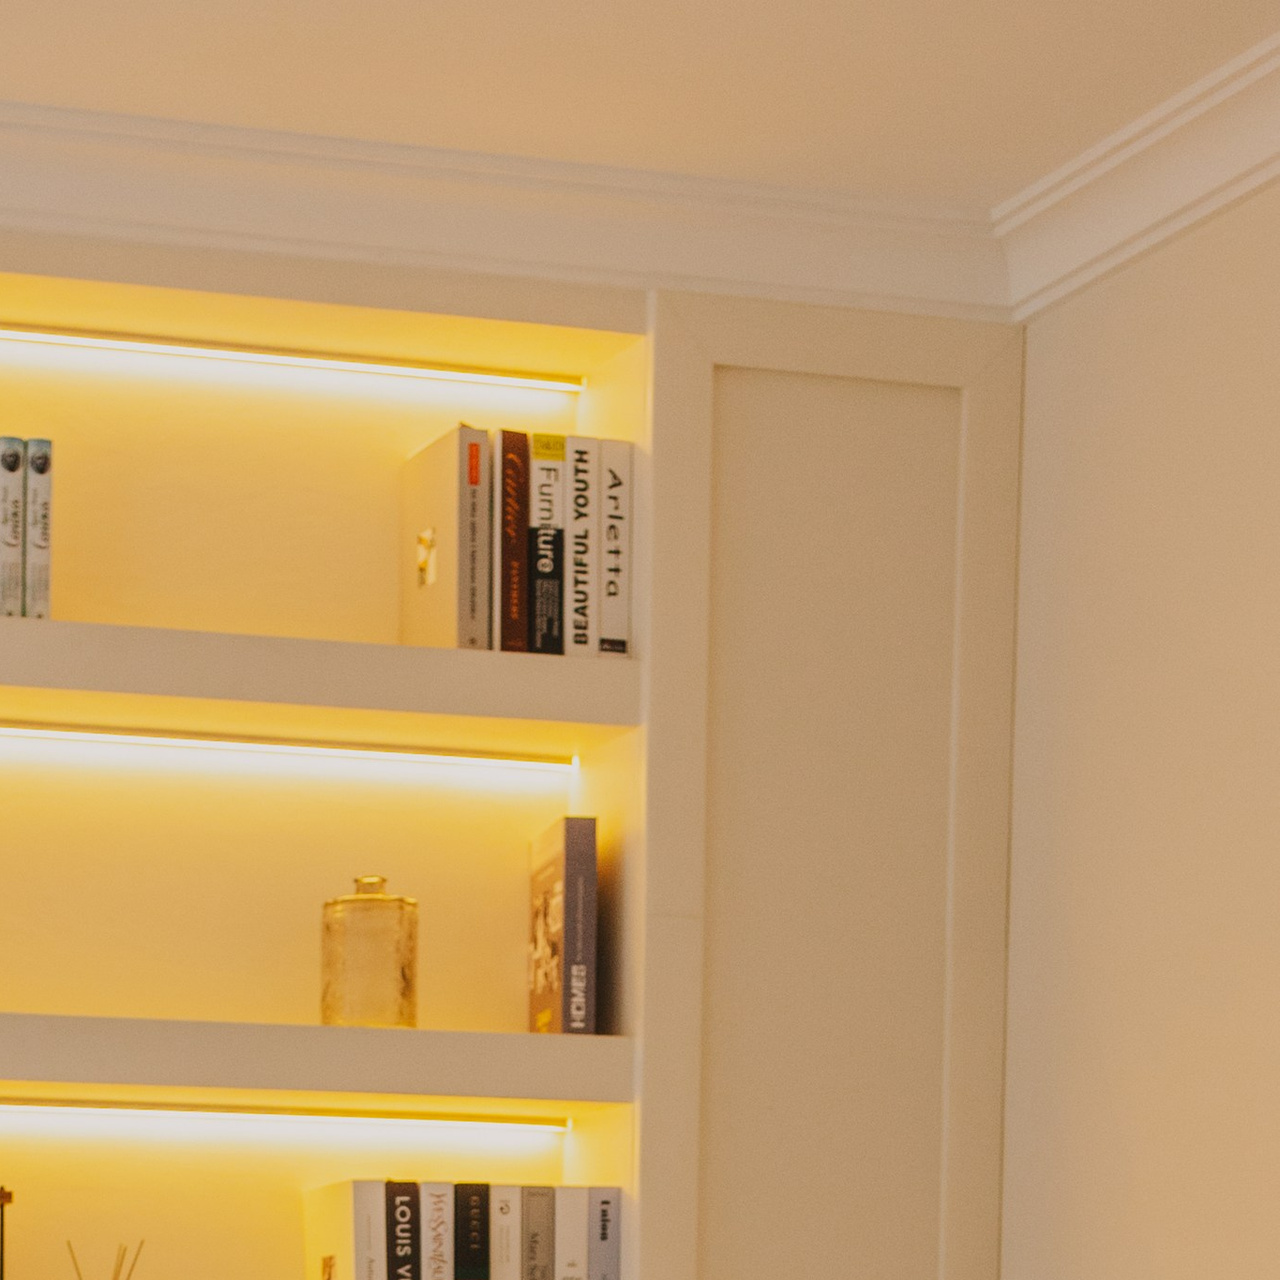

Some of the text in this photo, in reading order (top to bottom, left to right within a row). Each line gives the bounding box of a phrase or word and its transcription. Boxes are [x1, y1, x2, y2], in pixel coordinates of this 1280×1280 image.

[537, 466, 558, 573] Furniture
[574, 449, 589, 645] BEAUTIFUL YOUTH
[606, 468, 624, 597] Arletta
[395, 1196, 411, 1256] LOUIS
